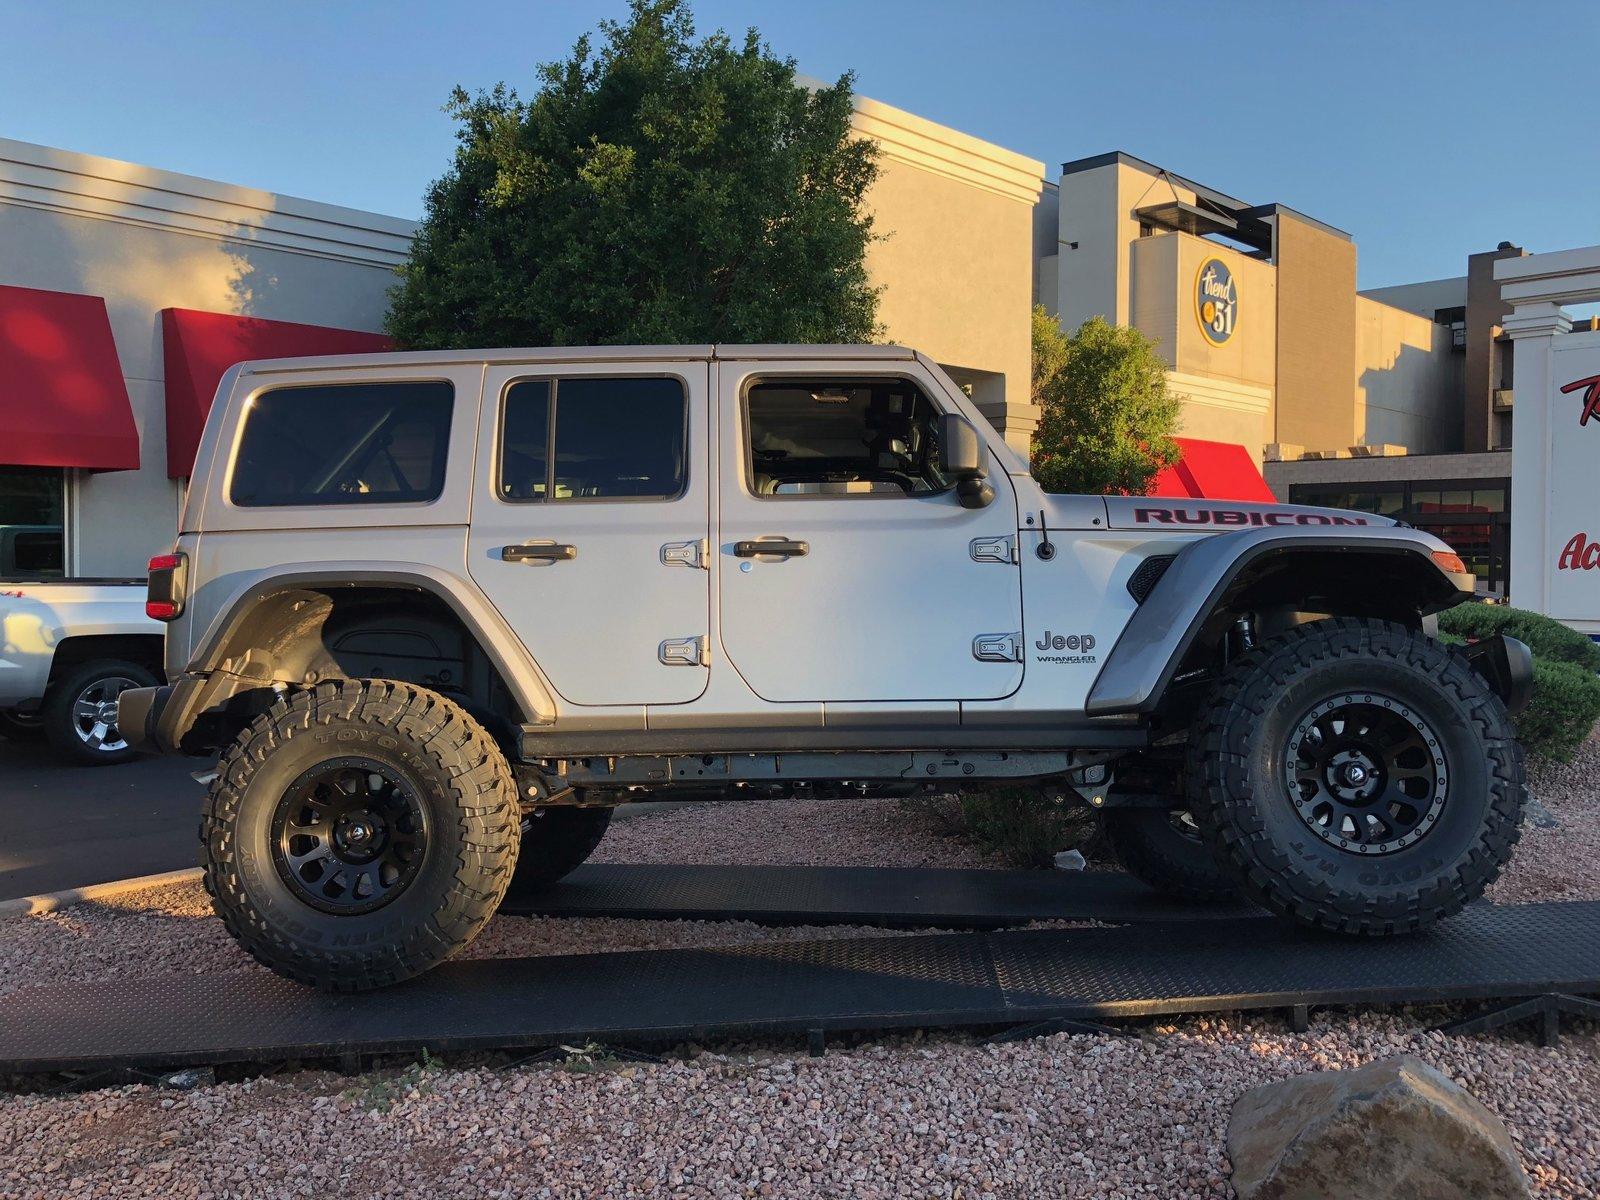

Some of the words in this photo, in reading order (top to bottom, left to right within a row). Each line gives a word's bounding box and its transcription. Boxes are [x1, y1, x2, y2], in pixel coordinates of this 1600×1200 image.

[1213, 301, 1232, 334] 51
[1558, 532, 1600, 571] Ac
[1035, 630, 1096, 653] Jeep
[315, 727, 398, 749] TOYO
